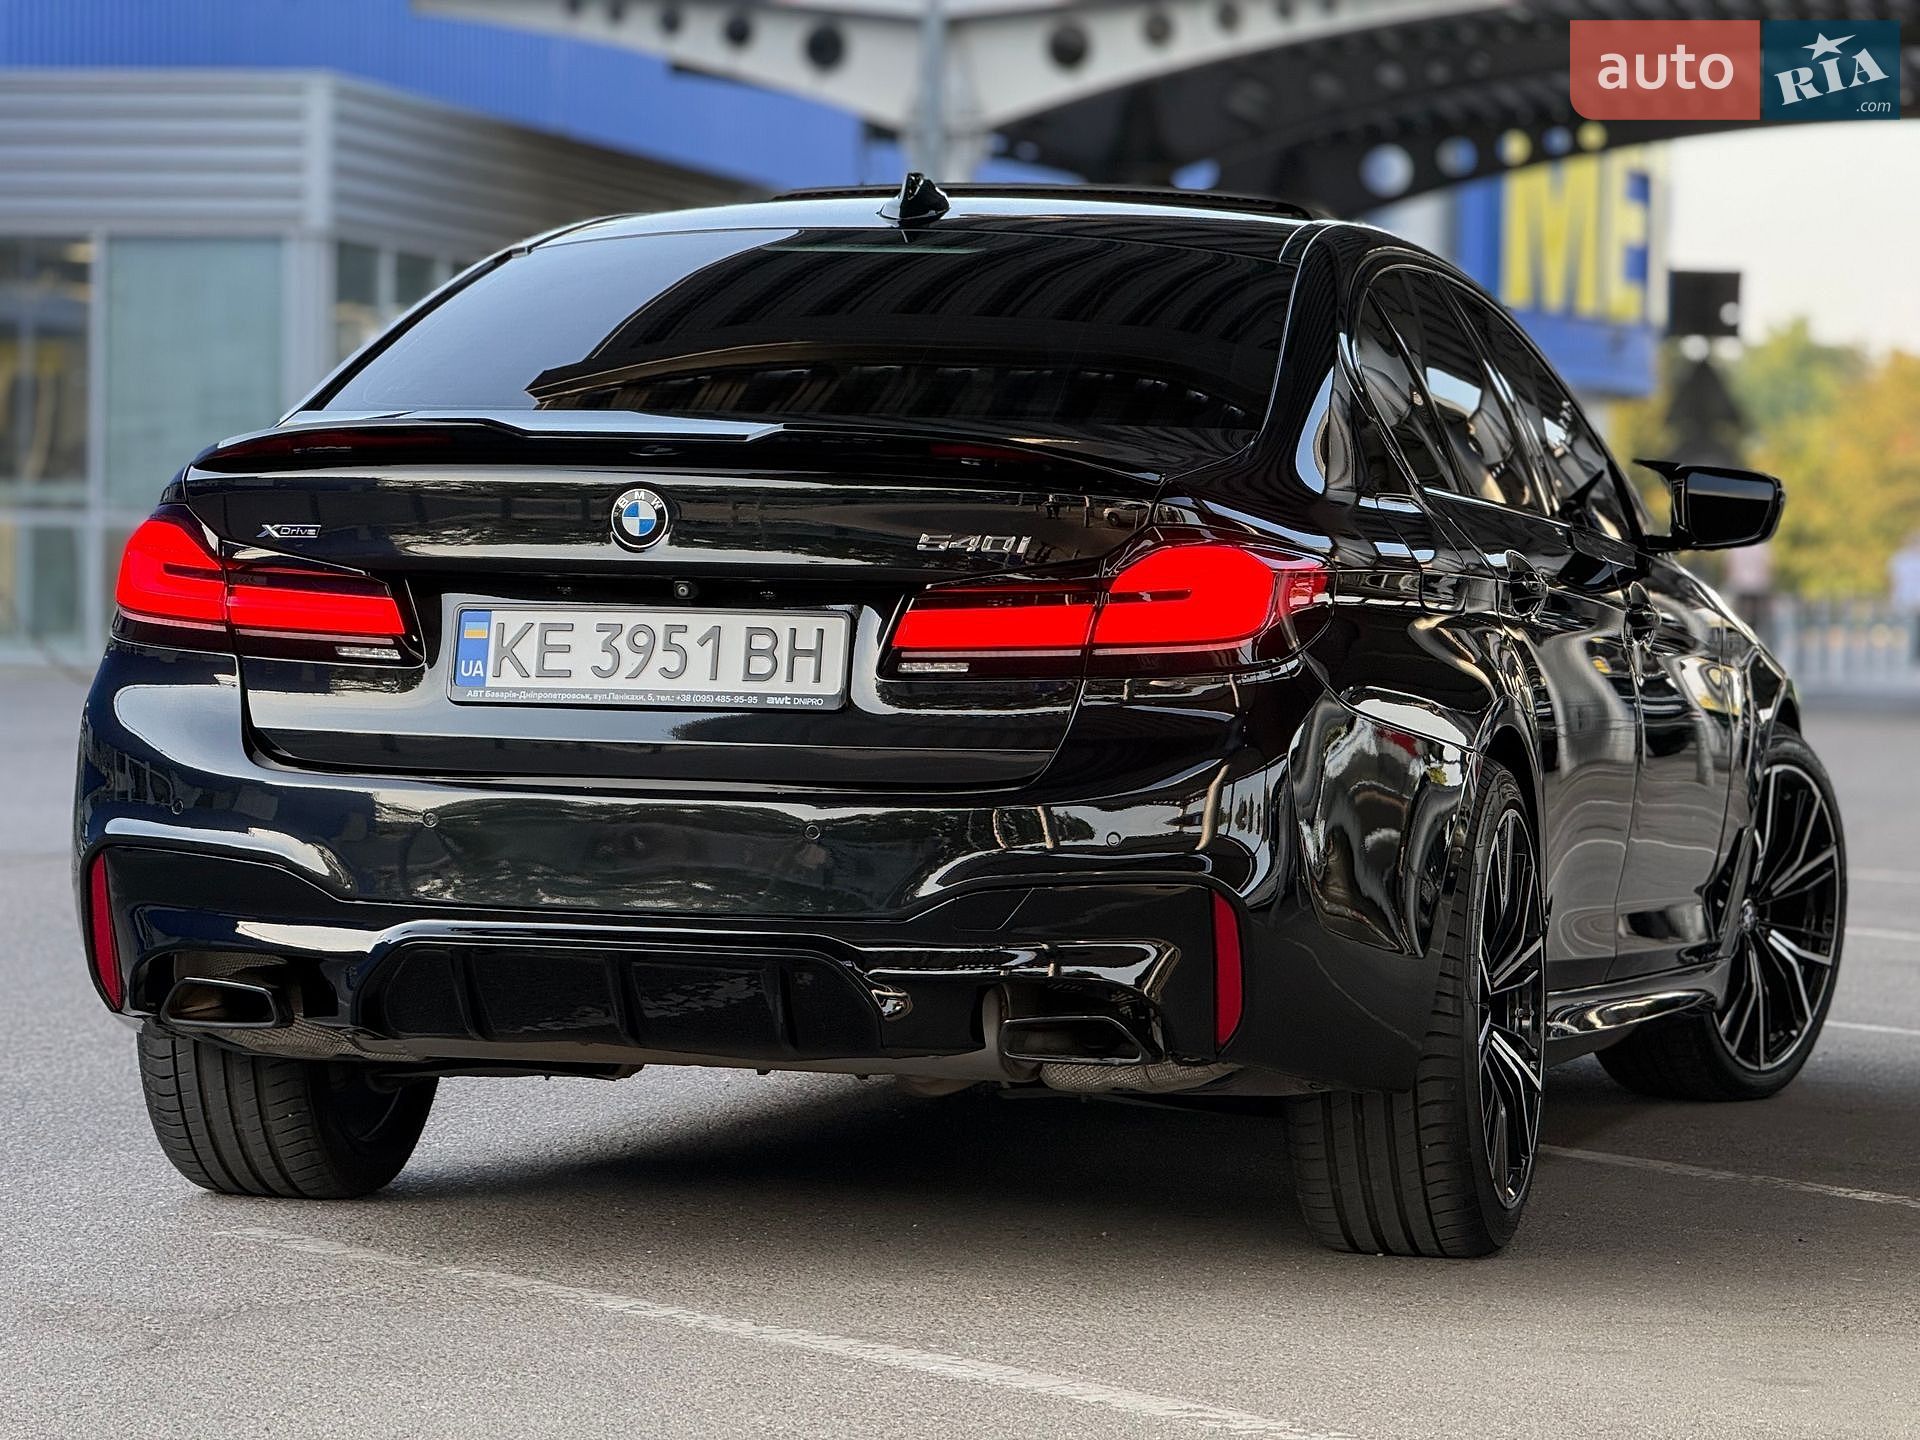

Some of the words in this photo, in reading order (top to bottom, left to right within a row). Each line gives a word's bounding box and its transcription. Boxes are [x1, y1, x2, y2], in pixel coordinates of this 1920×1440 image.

[617, 491, 663, 510] BMW
[492, 622, 574, 678] KE
[590, 623, 722, 681] 3951
[742, 626, 825, 684] BH
[461, 659, 485, 677] UA
[692, 696, 714, 704] (095)
[715, 696, 758, 704] 485-95-95
[766, 696, 791, 705] awt
[793, 698, 824, 706] DNIPRO
